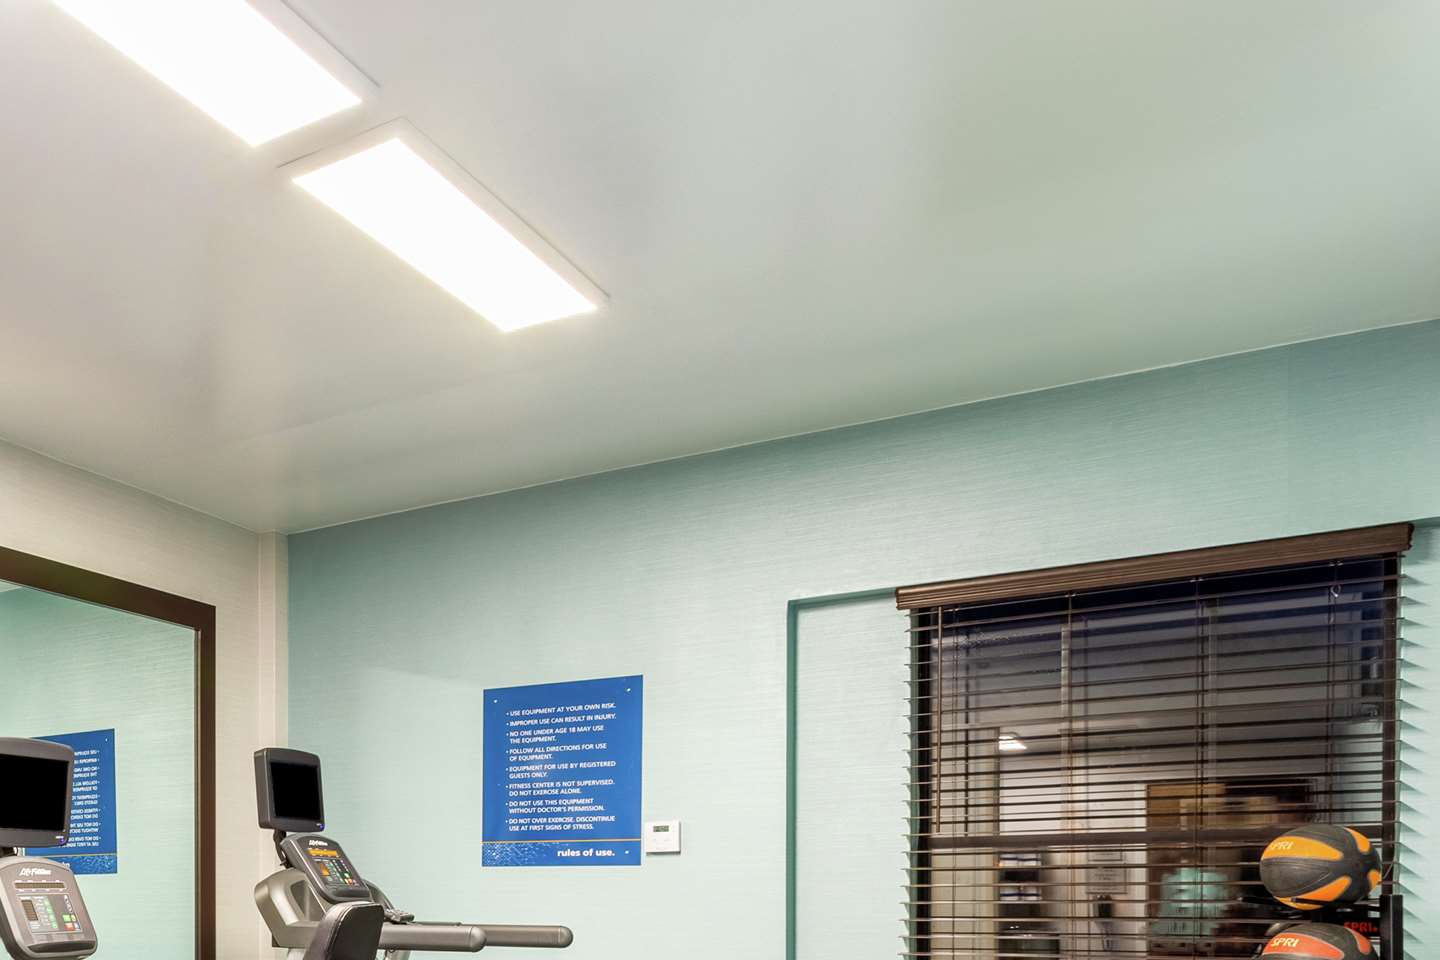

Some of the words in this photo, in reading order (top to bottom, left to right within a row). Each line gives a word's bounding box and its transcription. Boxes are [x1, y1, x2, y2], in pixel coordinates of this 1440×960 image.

[522, 707, 555, 715] EQUIPMENT
[510, 719, 538, 727] IMPROPER
[546, 744, 580, 752] DIRECTIONS
[509, 764, 543, 772] EQUIPMENT
[576, 815, 615, 823] DISCONTINUE
[1270, 840, 1294, 851] SPRI
[582, 848, 593, 856] of
[1271, 937, 1299, 948] SPRI
